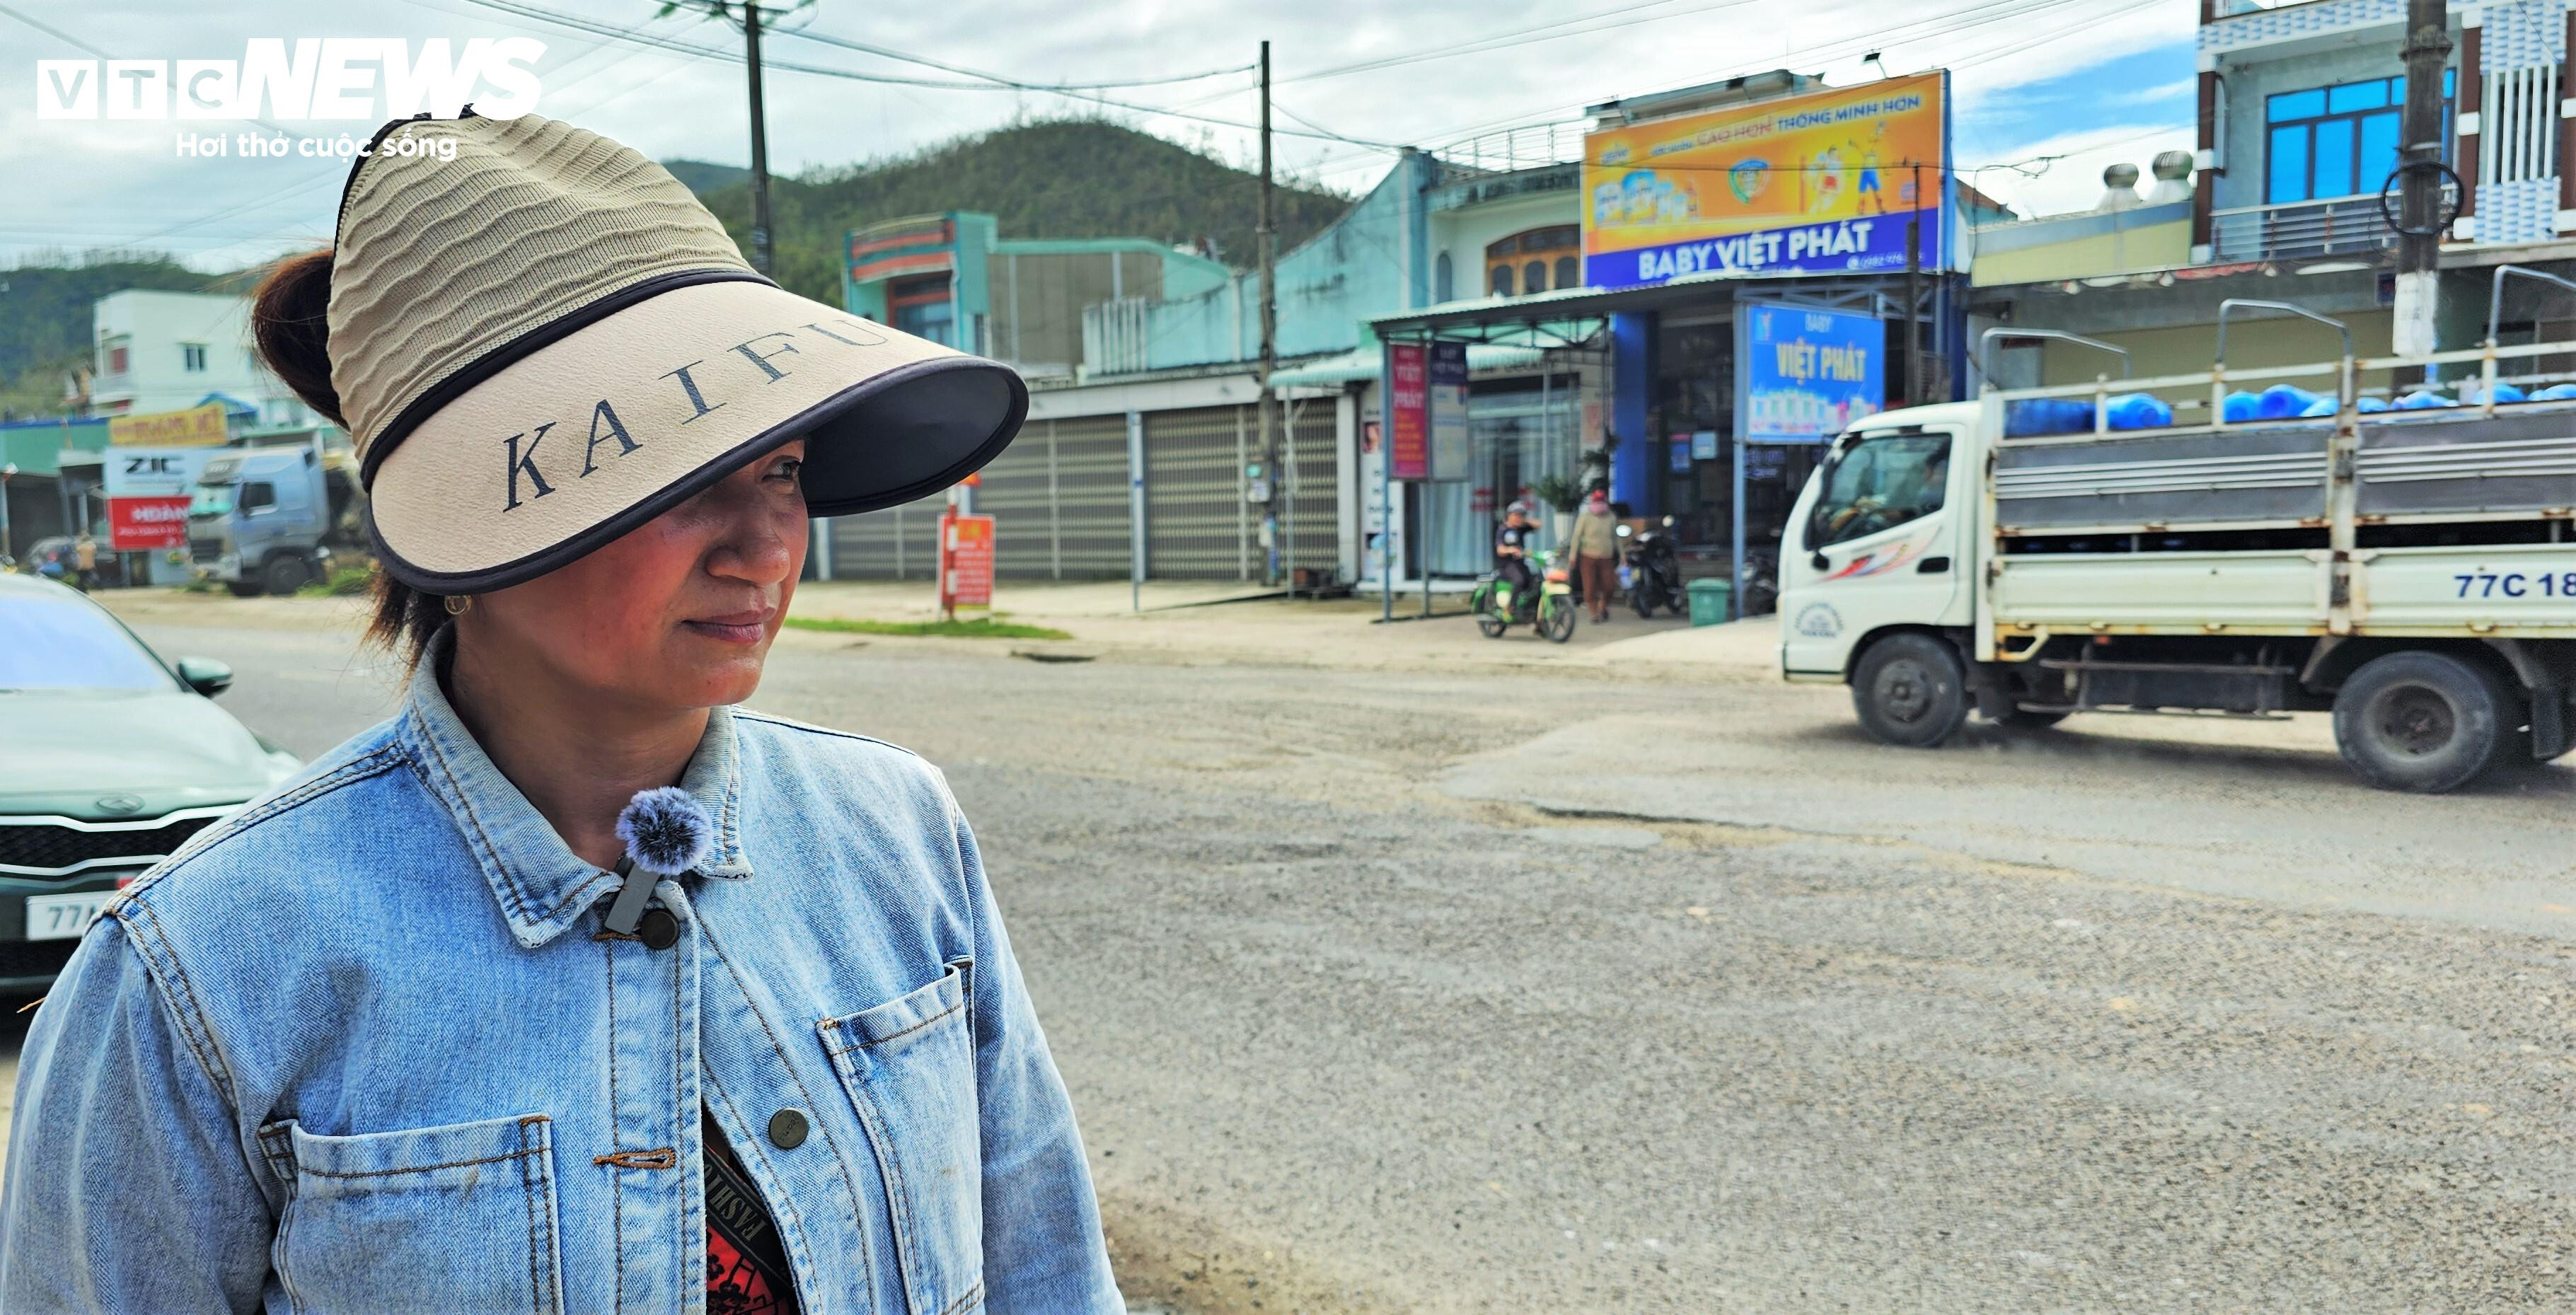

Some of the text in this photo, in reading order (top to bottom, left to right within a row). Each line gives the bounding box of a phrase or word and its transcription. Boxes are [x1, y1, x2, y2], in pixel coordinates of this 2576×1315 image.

[1777, 110, 1831, 131] THÔNG
[1835, 103, 1878, 122] MINH
[1883, 96, 1919, 112] HƠN
[1639, 219, 1873, 281] BABY VIỆT PHÁT
[1806, 313, 1832, 333] BABY
[1777, 336, 1866, 386] VIỆT PHÁT
[503, 320, 889, 513] KAIFU
[125, 456, 185, 475] ZIC
[2454, 572, 2576, 598] 77C 18
